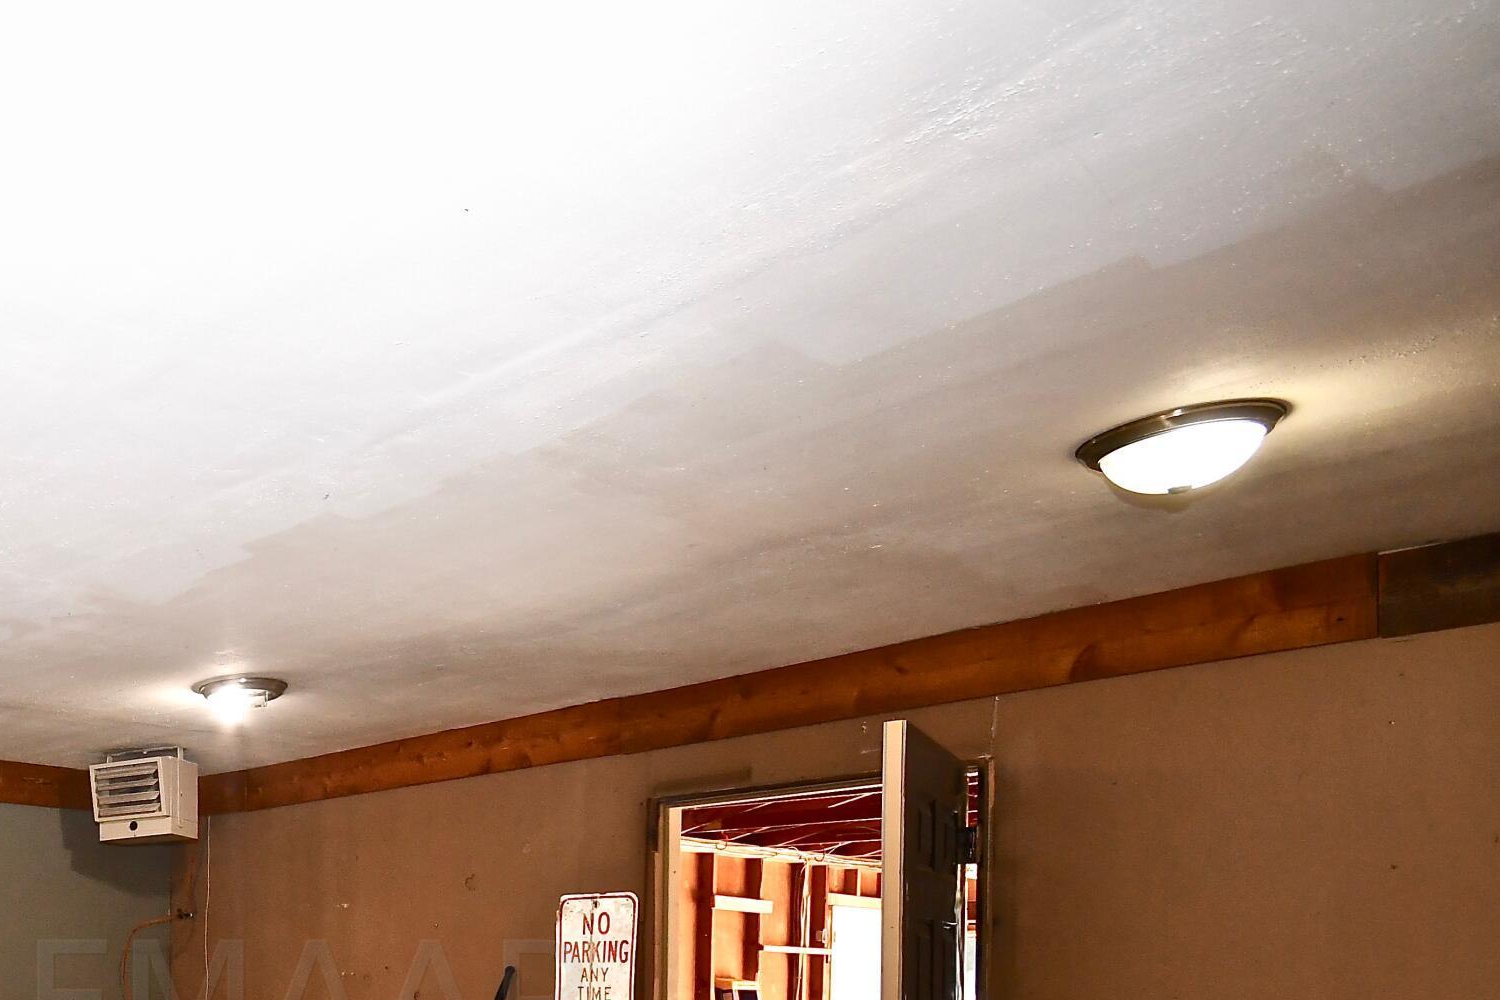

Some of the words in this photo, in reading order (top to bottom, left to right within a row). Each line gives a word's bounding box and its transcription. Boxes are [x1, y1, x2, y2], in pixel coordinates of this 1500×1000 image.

[582, 912, 610, 935] NO
[563, 940, 629, 963] PARKING
[580, 967, 609, 983] ANY
